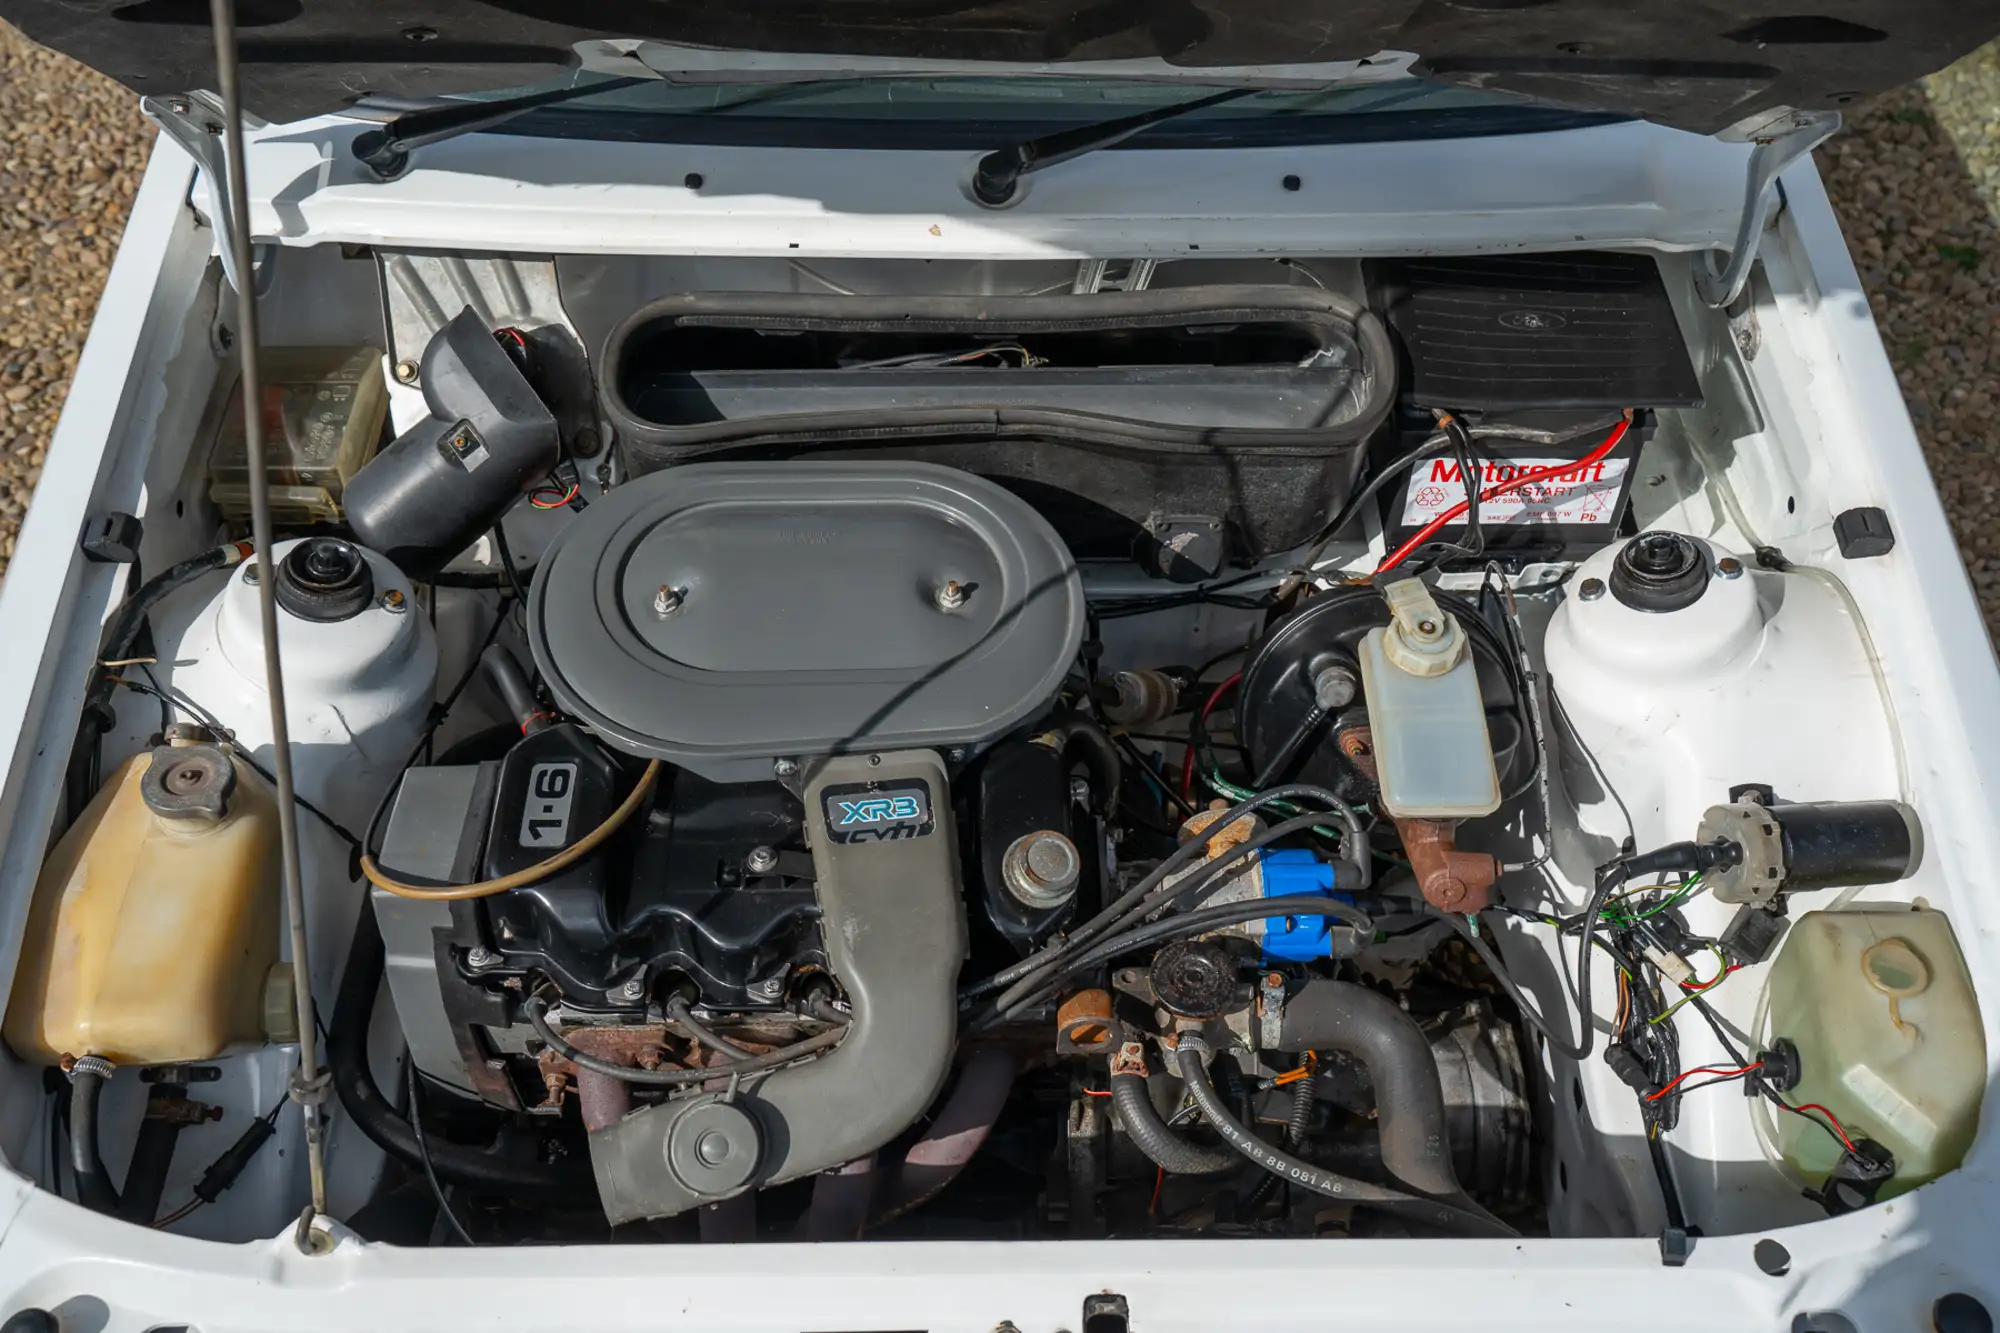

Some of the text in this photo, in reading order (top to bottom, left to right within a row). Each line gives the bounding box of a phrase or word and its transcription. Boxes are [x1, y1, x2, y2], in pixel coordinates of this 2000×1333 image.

[1430, 459, 1605, 482] Mtorcaft
[1580, 512, 1598, 522] Pb
[838, 796, 919, 825] XR3
[1290, 1167, 1317, 1185] 081
[1320, 1180, 1342, 1193] AB
